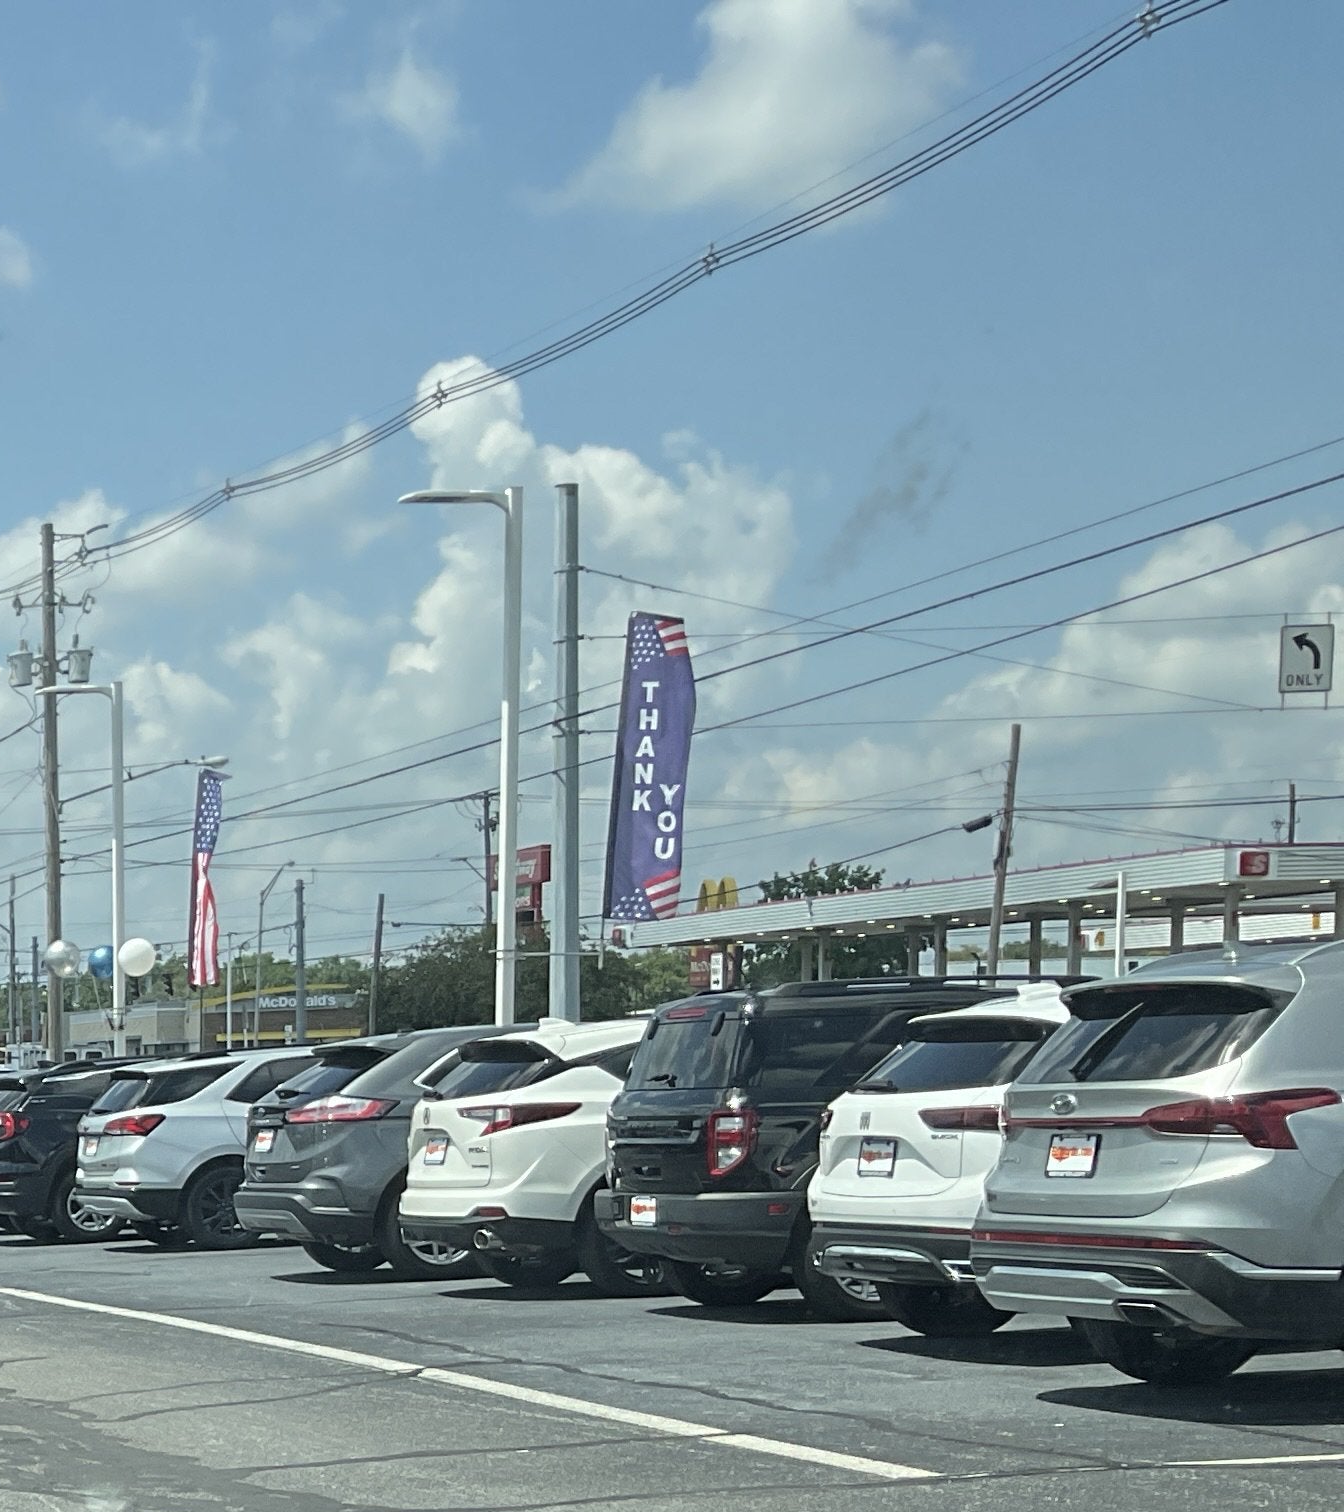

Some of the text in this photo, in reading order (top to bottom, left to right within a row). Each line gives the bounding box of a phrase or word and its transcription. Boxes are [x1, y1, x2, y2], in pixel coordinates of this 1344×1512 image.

[1285, 674, 1324, 687] ONLY
[631, 680, 660, 812] THANK
[654, 783, 681, 860] YOU
[258, 994, 337, 1009] McDoald's
